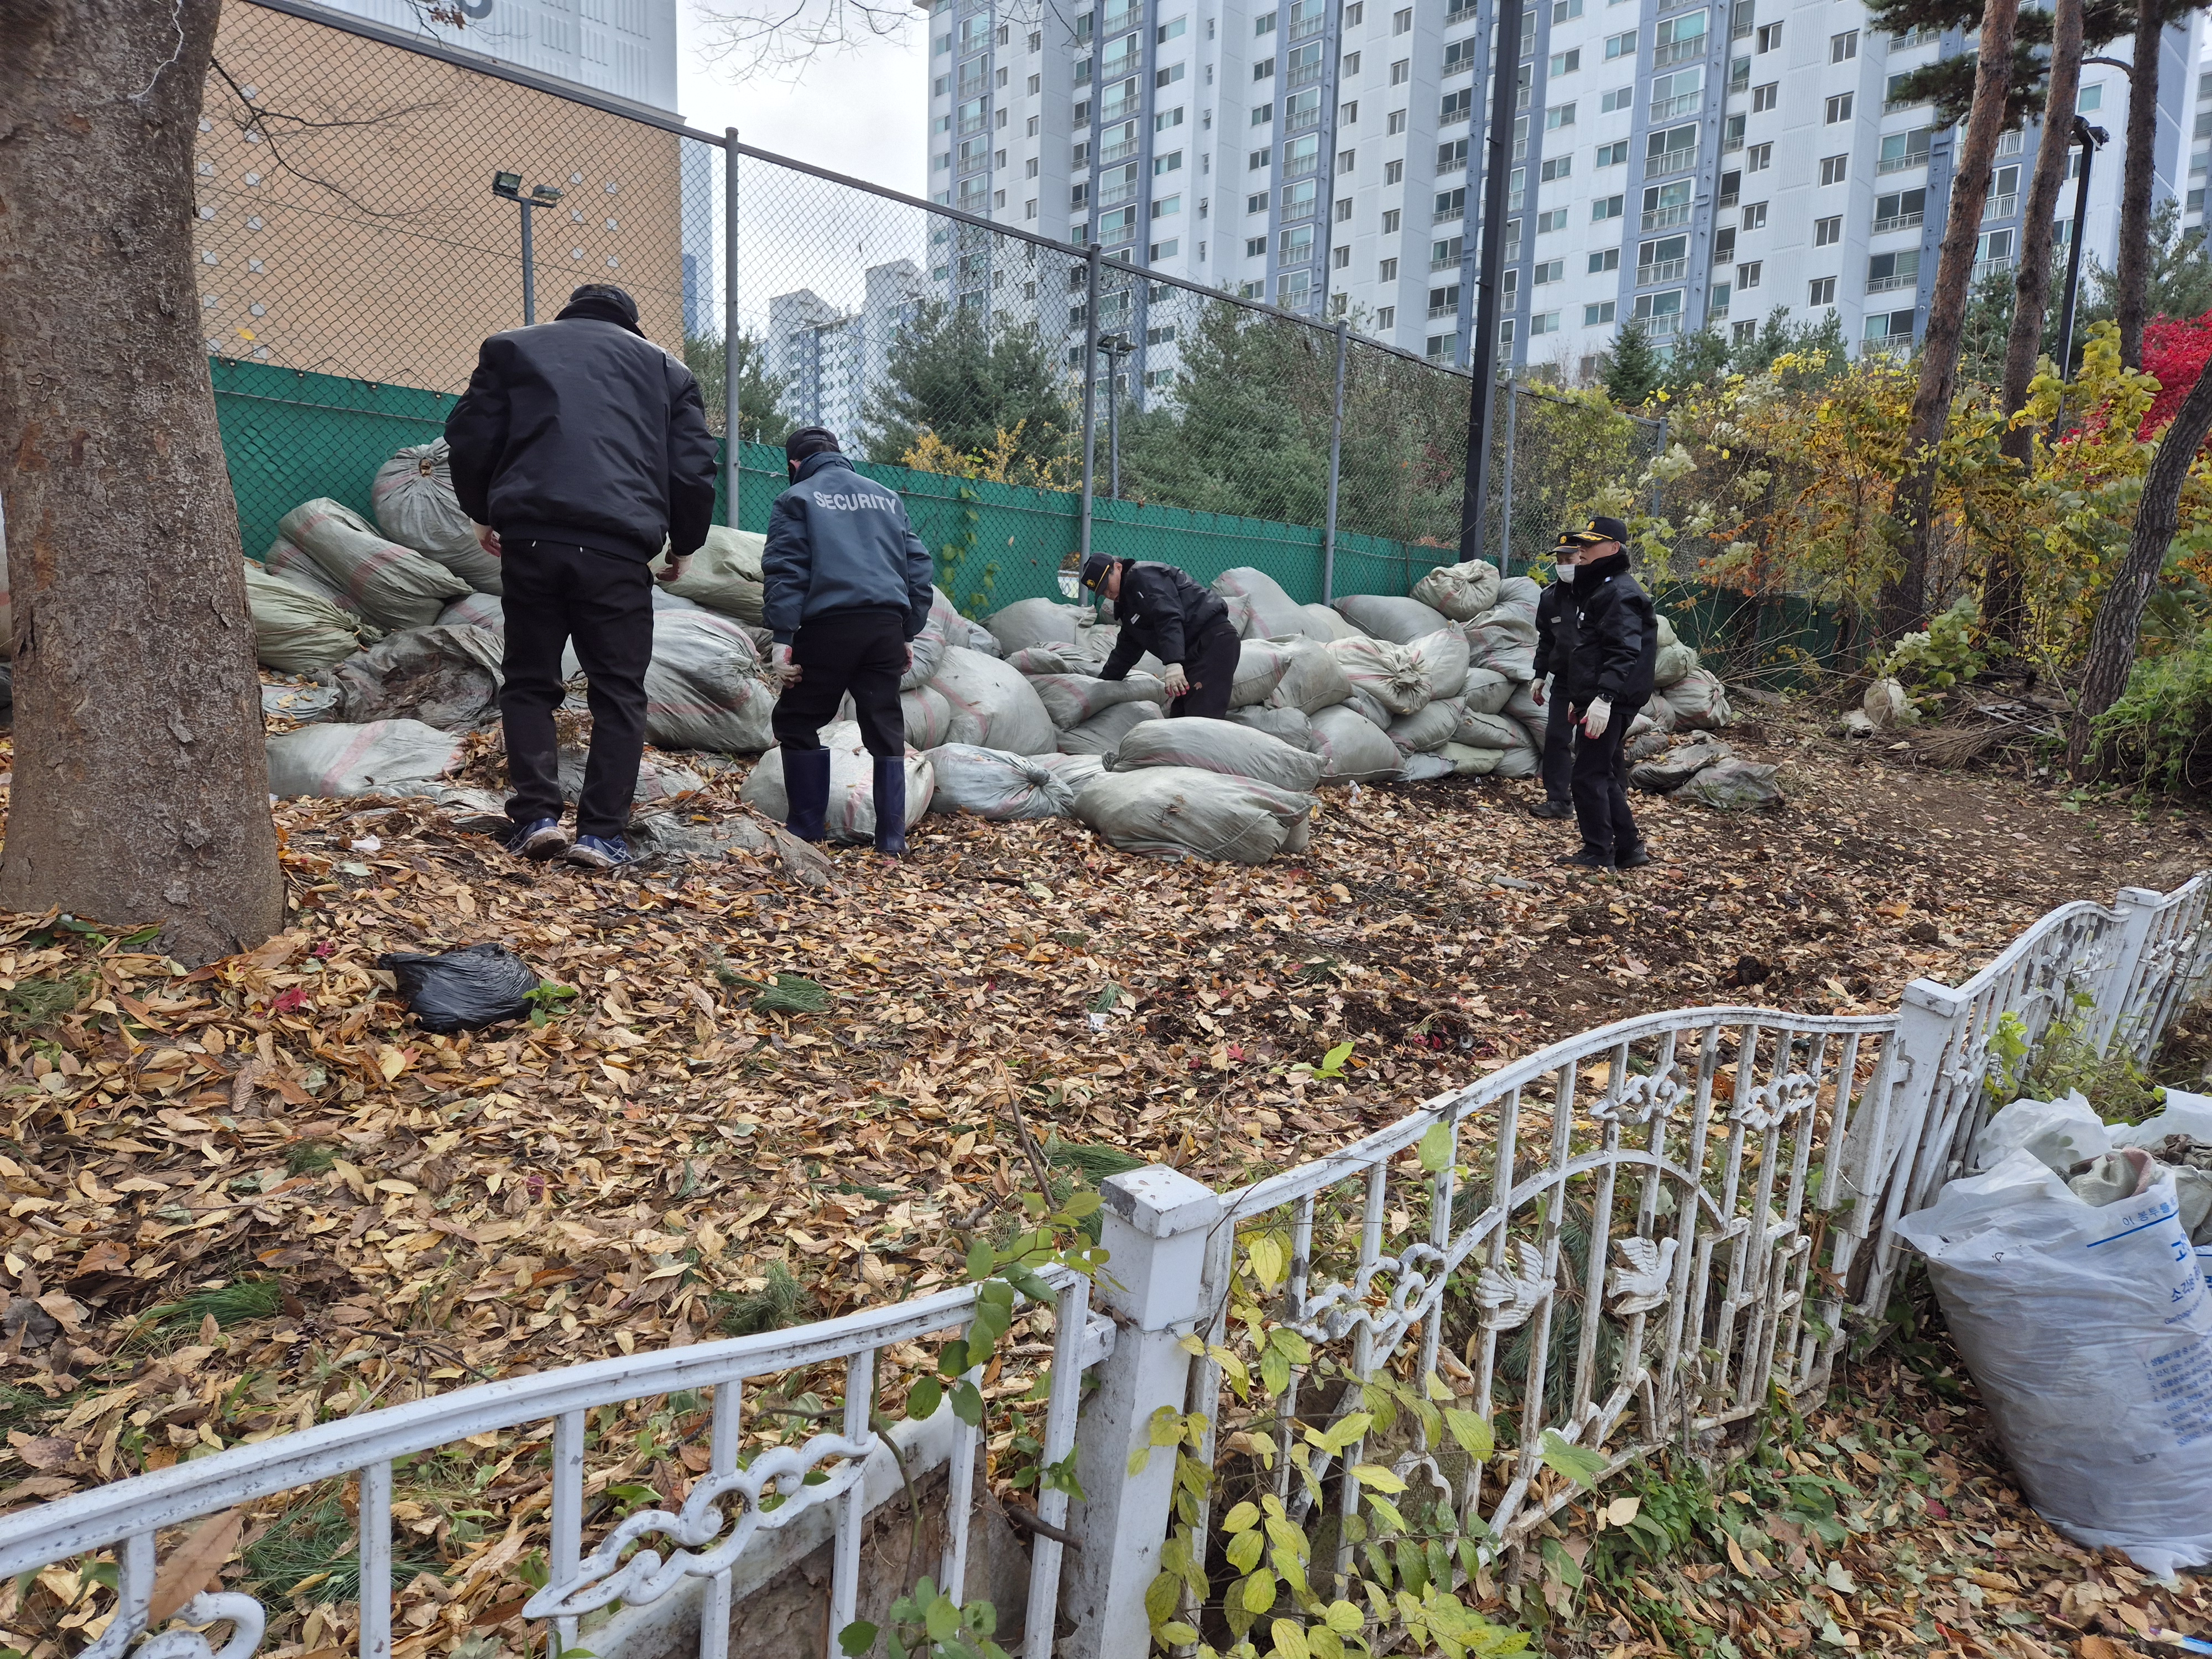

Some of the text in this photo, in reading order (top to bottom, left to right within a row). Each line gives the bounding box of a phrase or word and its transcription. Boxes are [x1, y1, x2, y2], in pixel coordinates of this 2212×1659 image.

[813, 491, 896, 514] SECURITY
[2122, 1202, 2171, 1226] 이 봉투를
